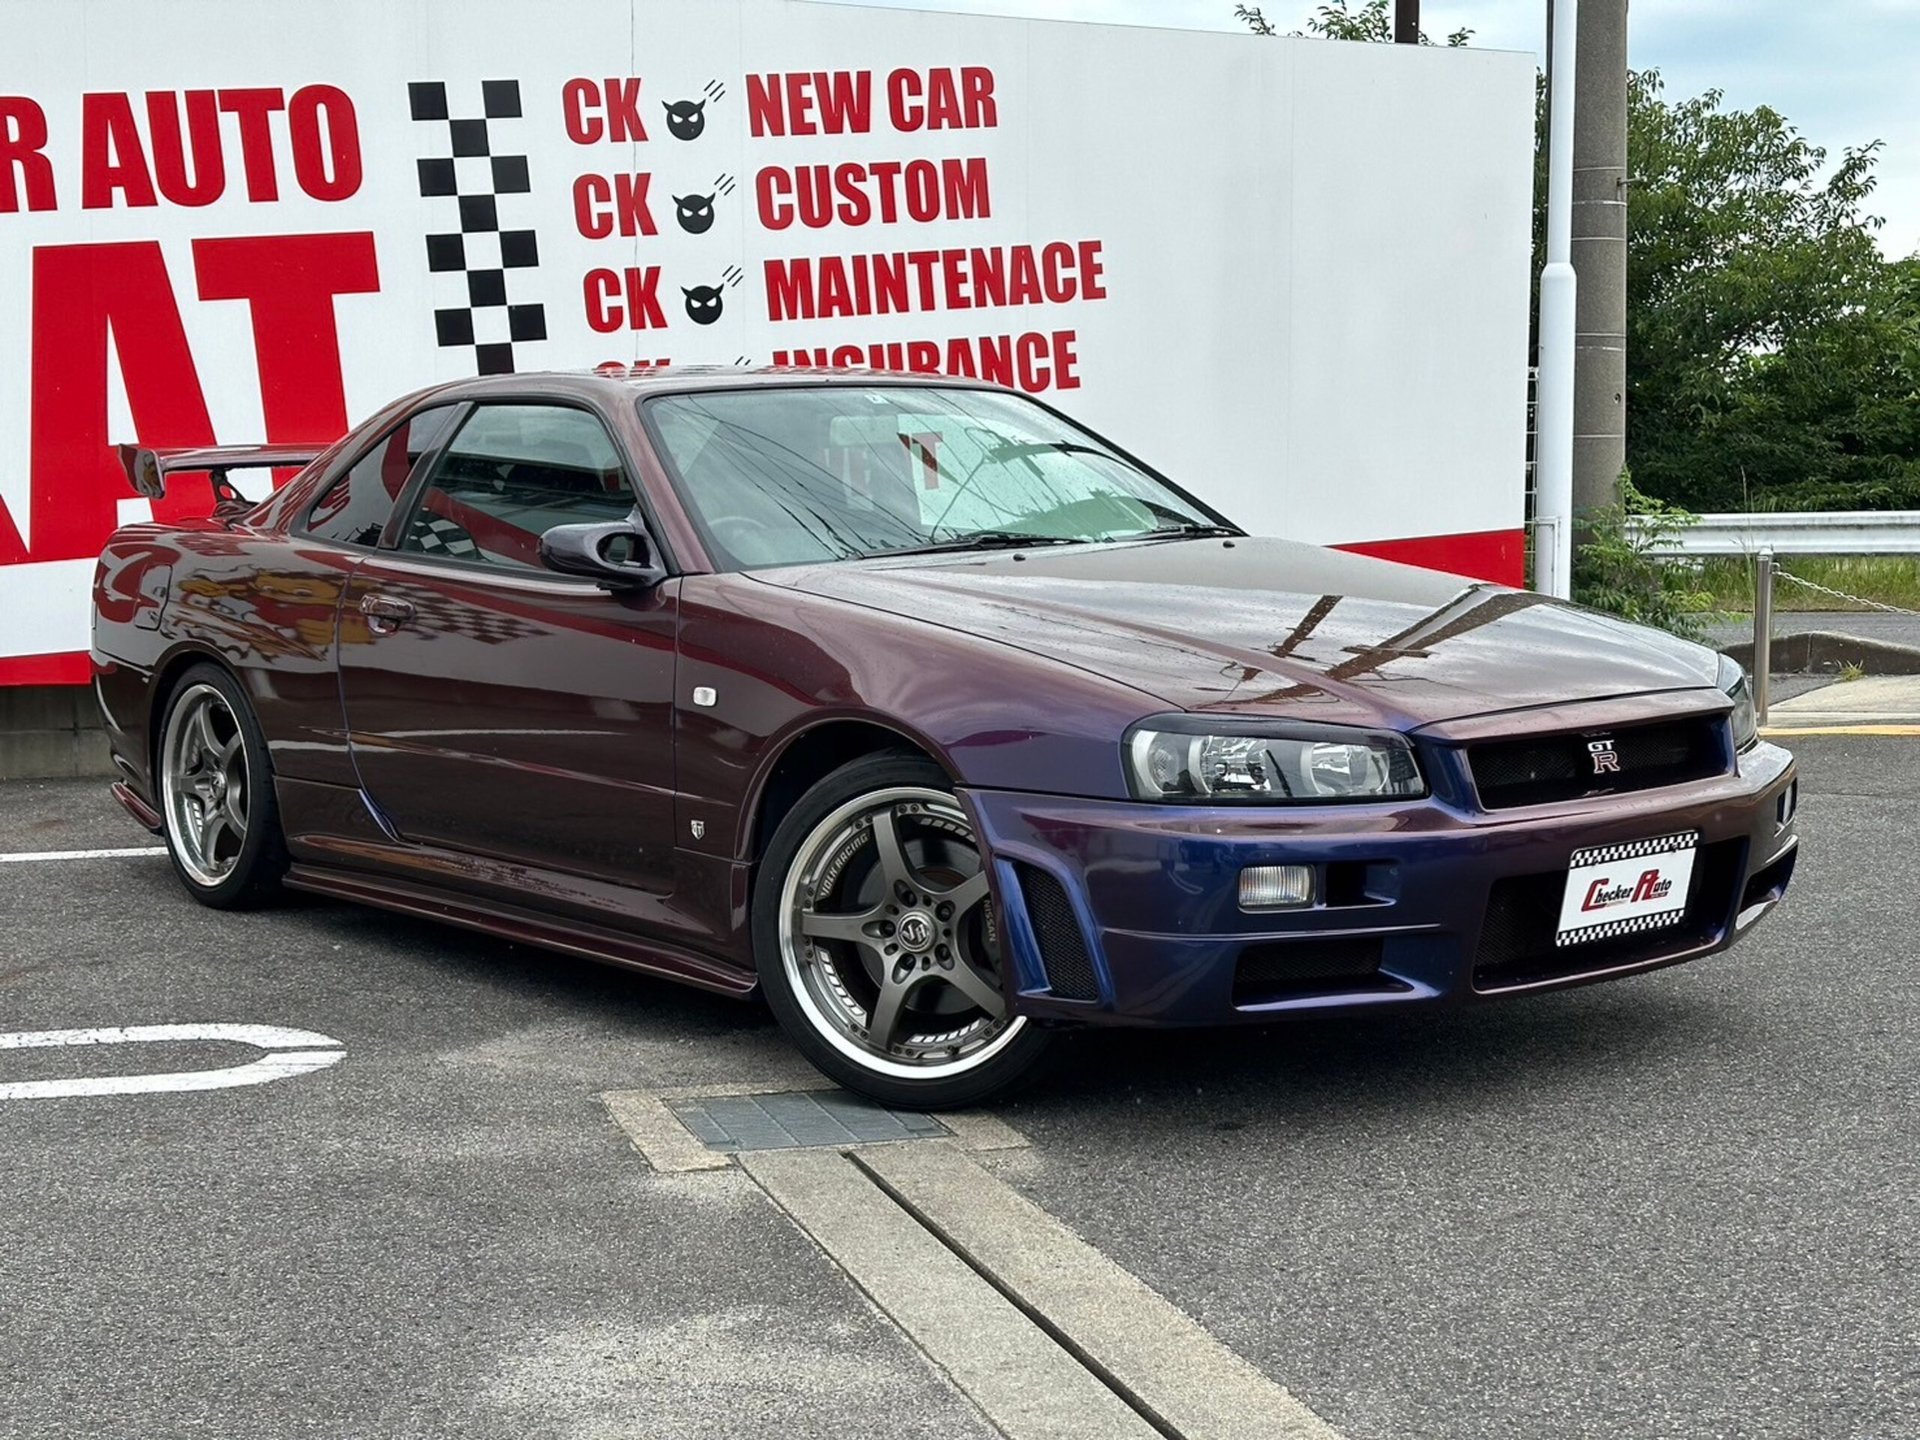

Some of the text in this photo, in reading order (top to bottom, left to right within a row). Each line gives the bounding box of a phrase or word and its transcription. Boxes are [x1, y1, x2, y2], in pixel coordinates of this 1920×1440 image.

[563, 66, 998, 144] CK NEW CAR
[82, 84, 363, 209] AUTO
[573, 158, 991, 240] CK CUSTOM
[583, 240, 1107, 334] CK MAINTENACE
[834, 832, 869, 868] RACING
[983, 899, 997, 942] NISSAN
[1581, 868, 1673, 912] Checker Auto
